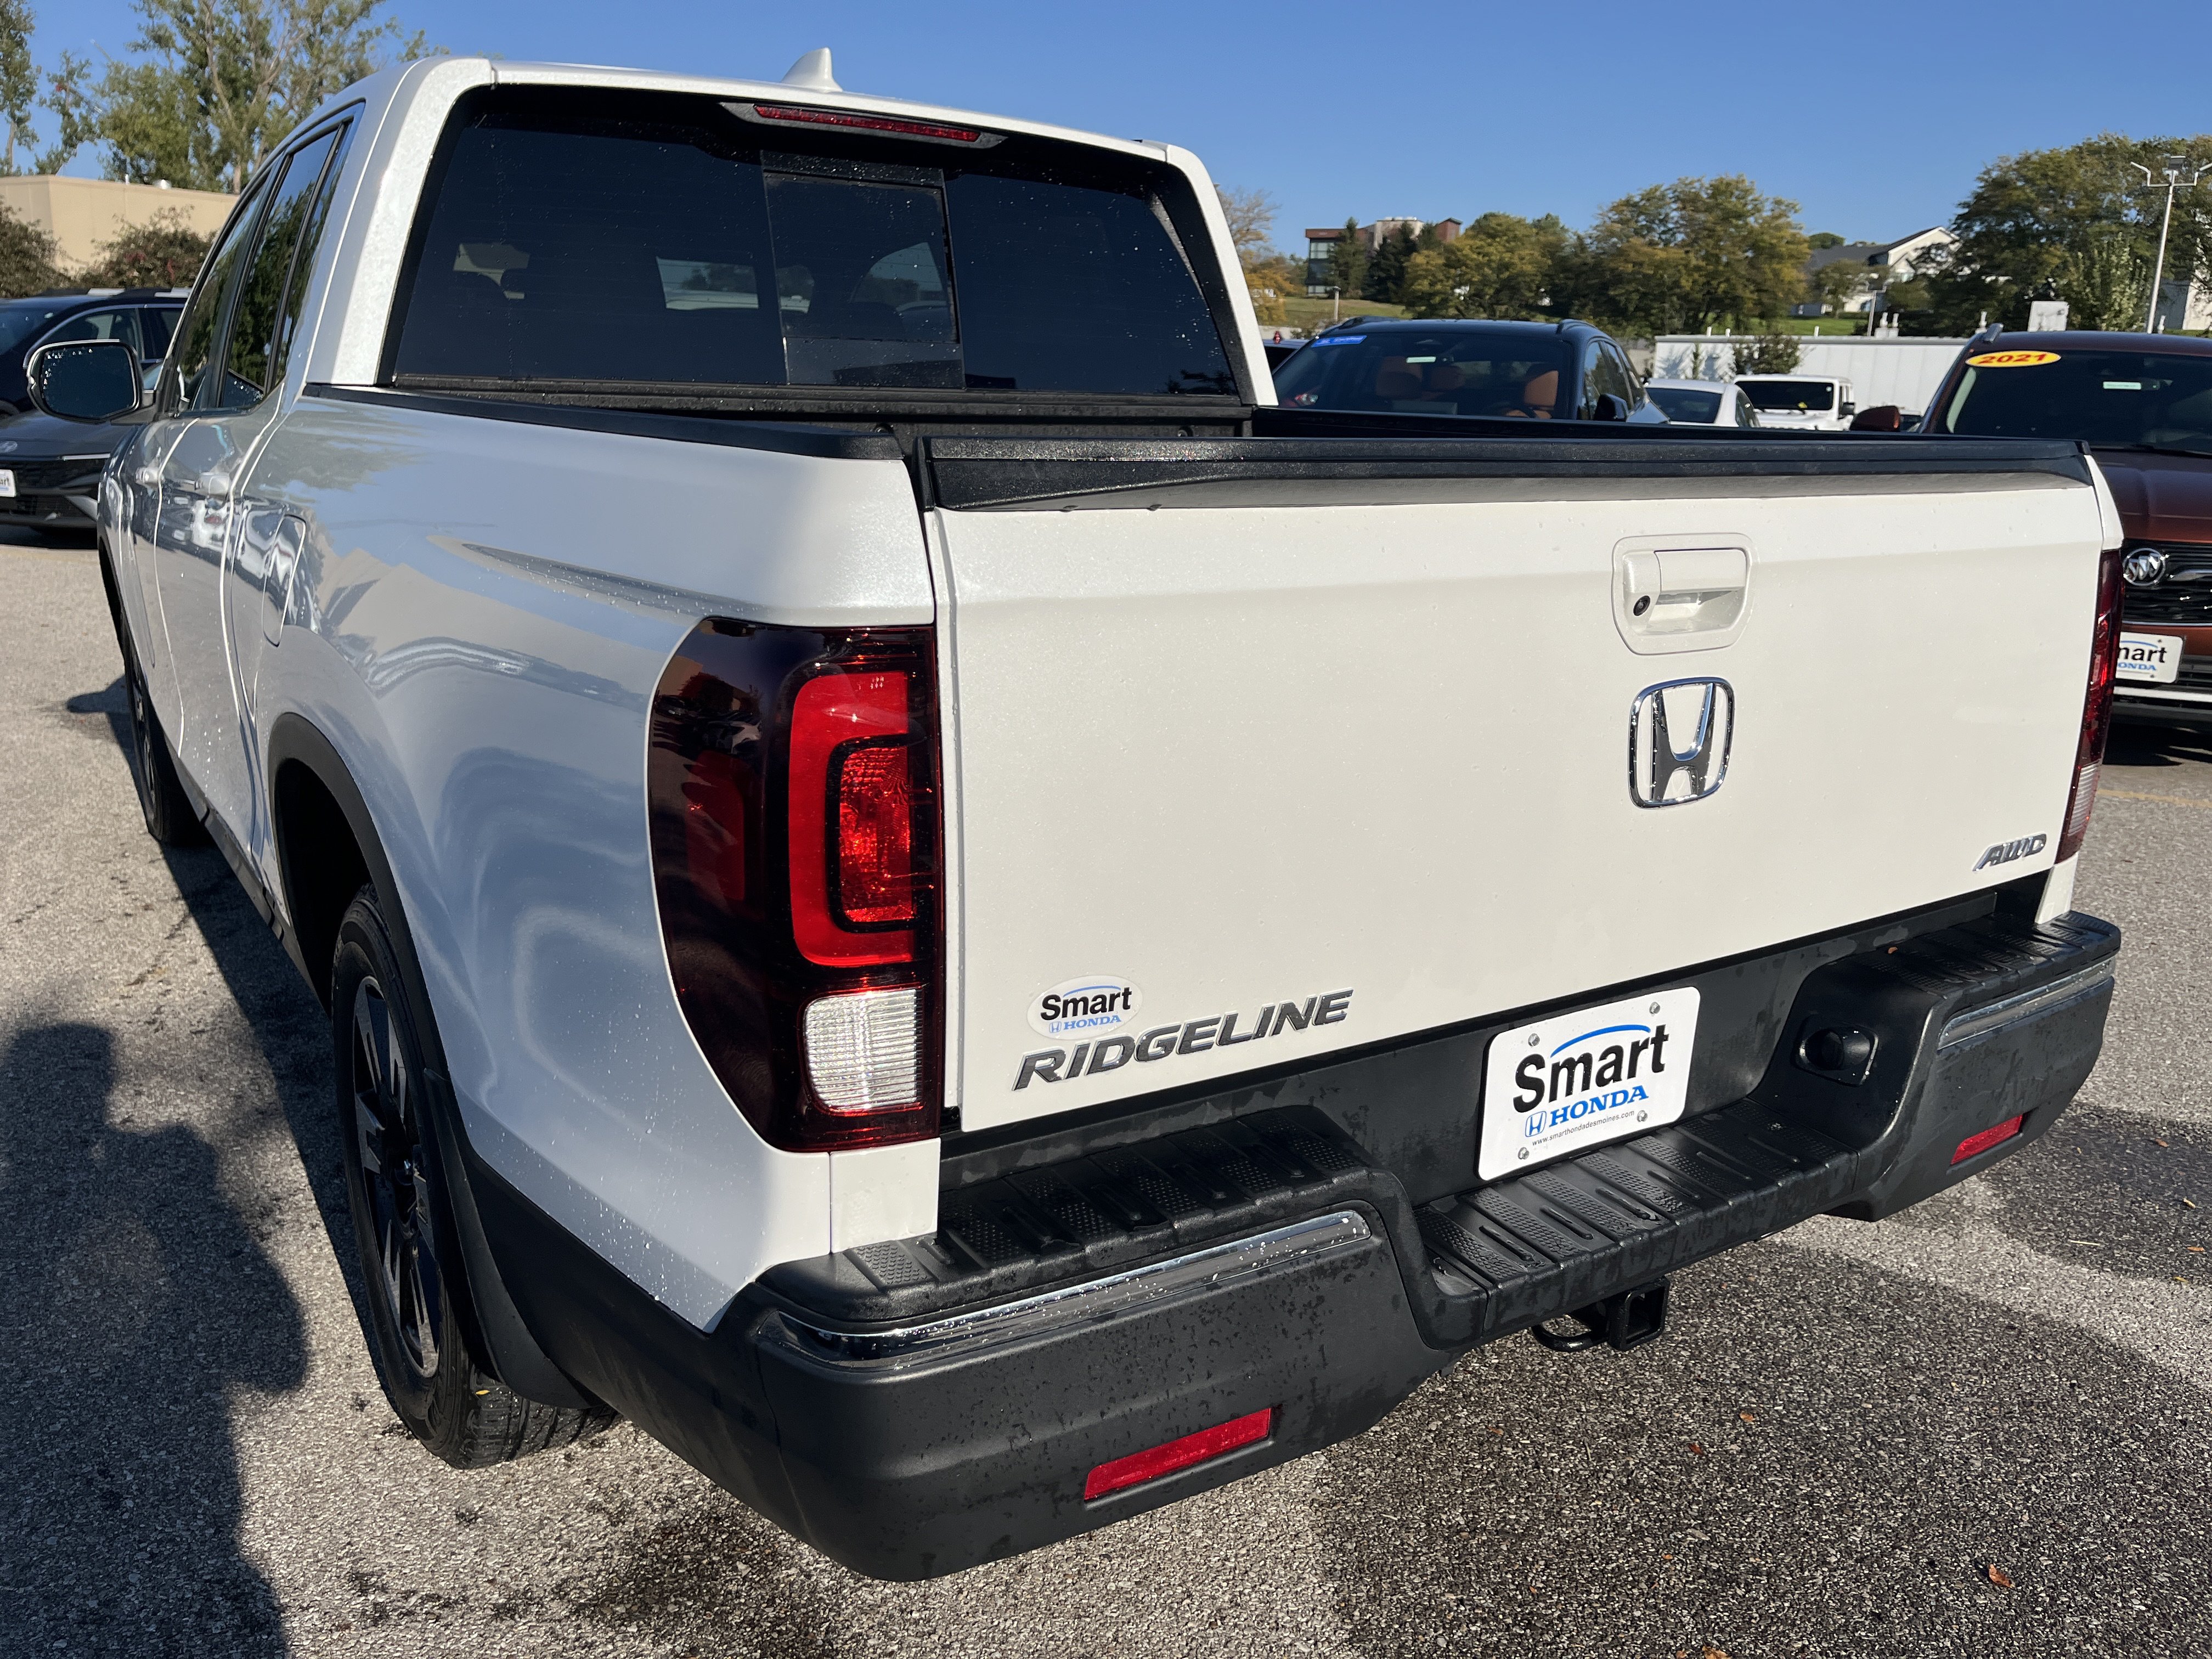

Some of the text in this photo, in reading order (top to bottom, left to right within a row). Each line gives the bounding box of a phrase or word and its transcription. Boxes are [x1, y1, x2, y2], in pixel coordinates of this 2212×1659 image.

[1977, 353, 2047, 364] 2021
[2118, 647, 2166, 663] art
[2118, 662, 2157, 671] ONDA
[1972, 833, 2047, 871] AWD
[1040, 987, 1132, 1020] Smart
[1012, 988, 1353, 1091] RIDGELINE
[1063, 1015, 1122, 1030] HONDA
[1513, 1024, 1669, 1113] Smart
[1549, 1085, 1649, 1127] HONDA
[1532, 1110, 1635, 1146] www.smarthondadesmoines.com
